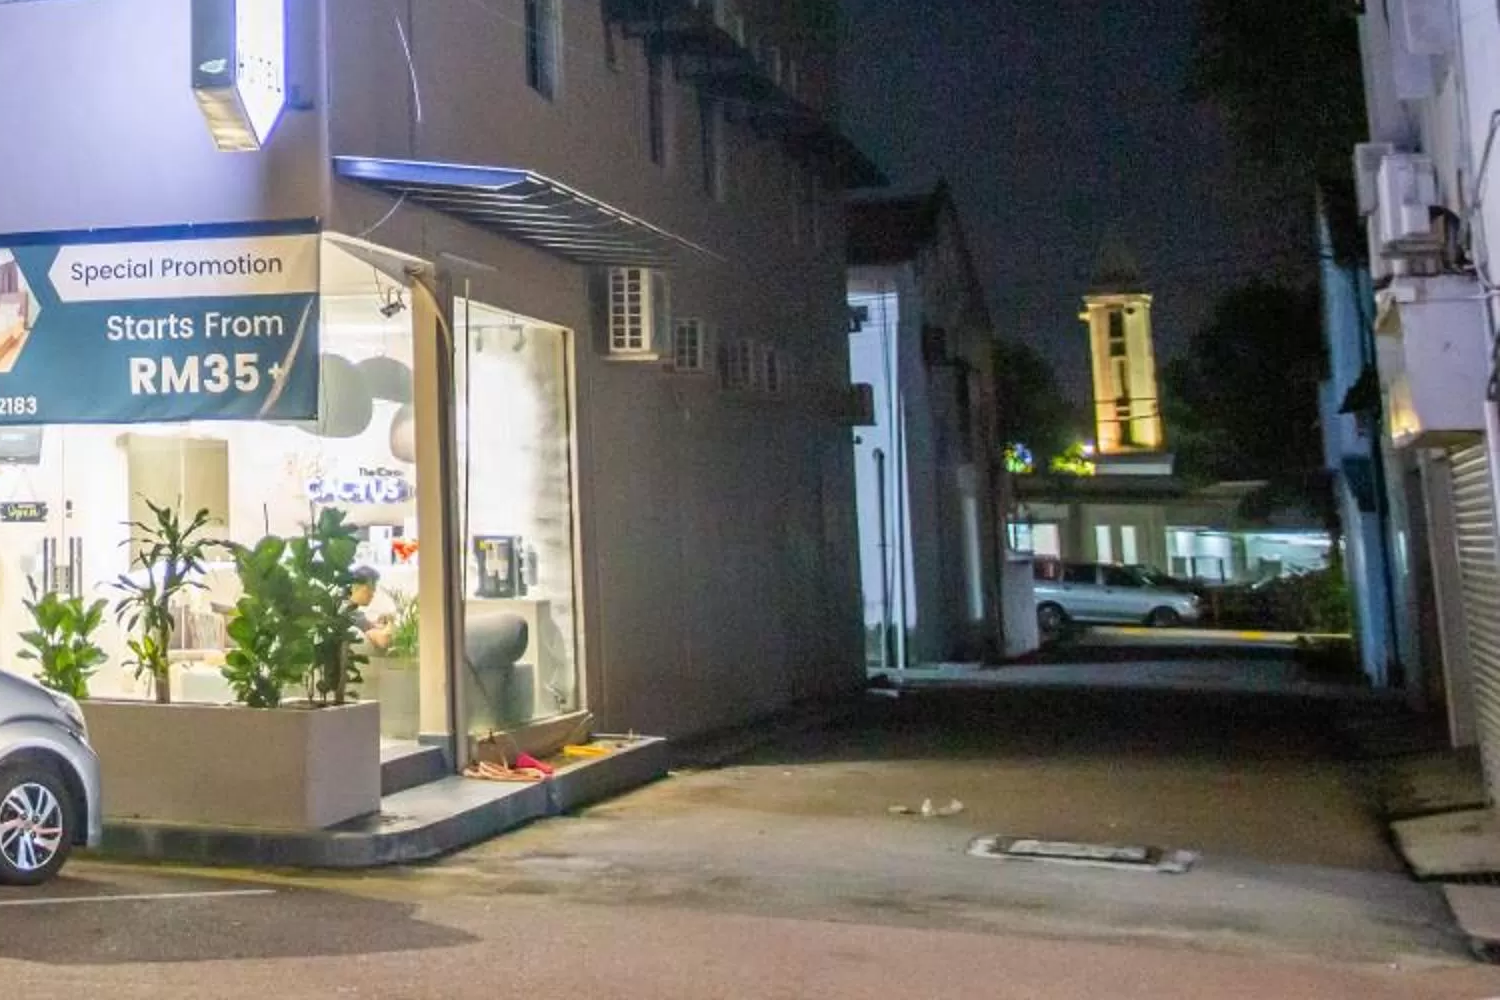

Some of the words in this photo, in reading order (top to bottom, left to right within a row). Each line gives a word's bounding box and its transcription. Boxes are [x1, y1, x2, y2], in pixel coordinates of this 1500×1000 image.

[70, 258, 153, 286] Special
[161, 253, 283, 278] Promotion
[106, 313, 195, 342] Starts
[204, 311, 284, 337] From
